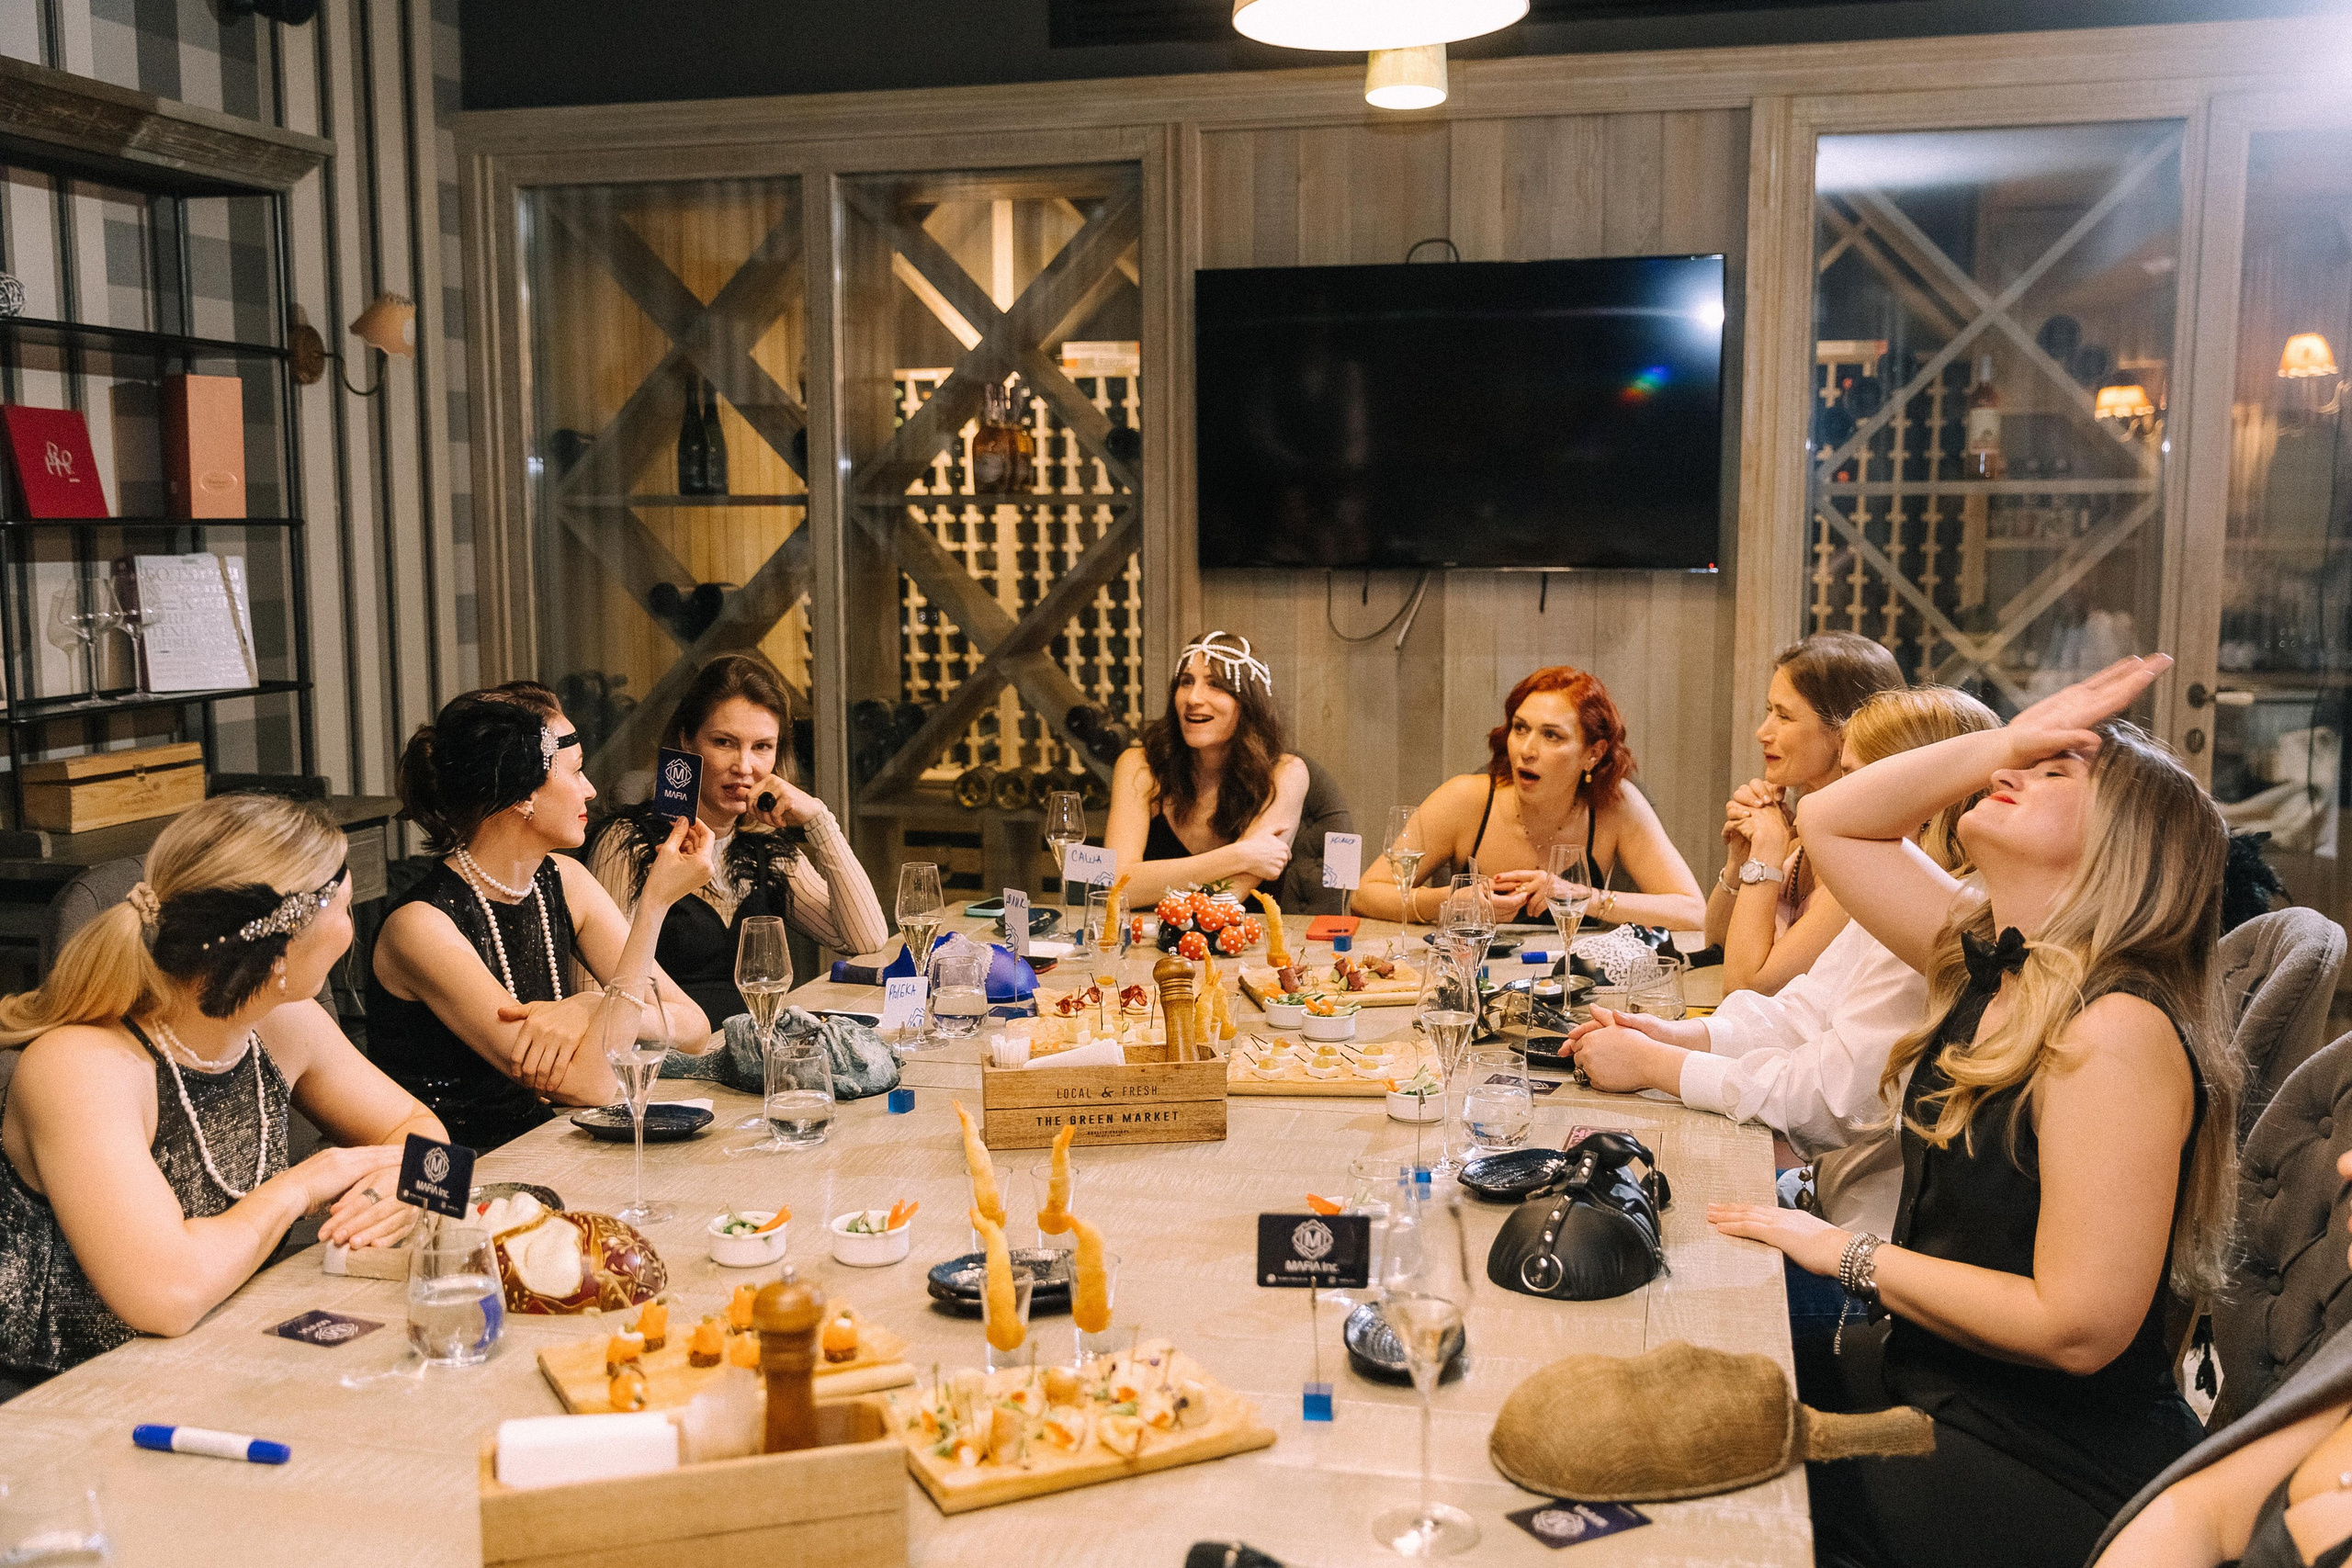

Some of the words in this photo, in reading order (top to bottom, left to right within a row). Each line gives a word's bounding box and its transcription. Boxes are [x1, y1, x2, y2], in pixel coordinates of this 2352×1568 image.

[664, 789, 688, 802] MAFIA
[888, 983, 917, 1001] РЫБКА
[1057, 1087, 1091, 1100] LOCAL
[1101, 1086, 1114, 1099] &
[1122, 1085, 1159, 1098] FRESH
[1036, 1115, 1061, 1127] THE
[1069, 1113, 1114, 1126] GREEN
[1122, 1111, 1180, 1123] MARKET
[415, 1179, 439, 1196] MAFIA
[1284, 1259, 1322, 1273] MAFIA
